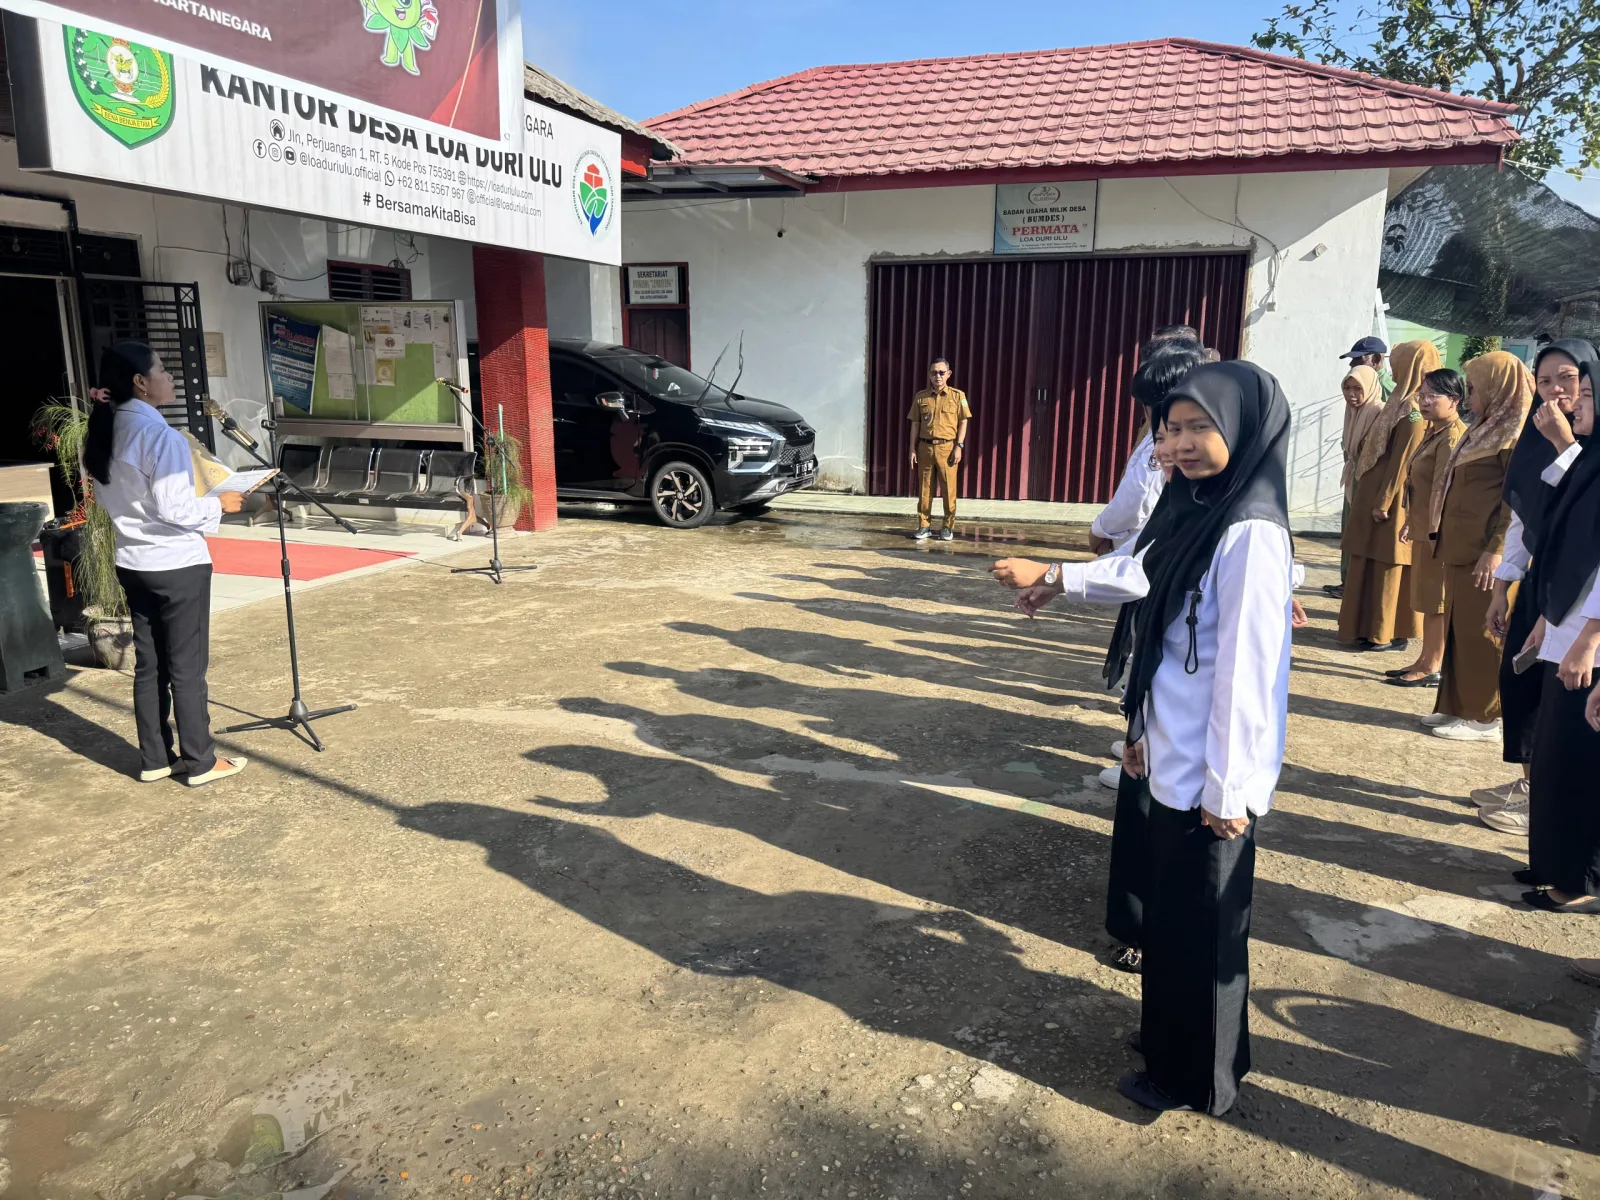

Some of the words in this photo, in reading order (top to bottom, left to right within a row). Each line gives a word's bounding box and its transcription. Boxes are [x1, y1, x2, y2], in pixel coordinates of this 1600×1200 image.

[524, 114, 554, 140] GARA
[307, 133, 357, 159] Perjuangan
[383, 153, 390, 166] 5
[391, 155, 412, 171] Kode
[413, 160, 427, 175] Pos
[428, 164, 456, 182] 755391
[529, 155, 562, 188] ULU
[299, 151, 382, 182] @loaduriulu.official
[397, 175, 413, 189] +62
[414, 178, 430, 192] 811
[431, 182, 450, 197] 5567
[451, 187, 466, 201] 967
[376, 193, 476, 226] BersamaKitaBisa
